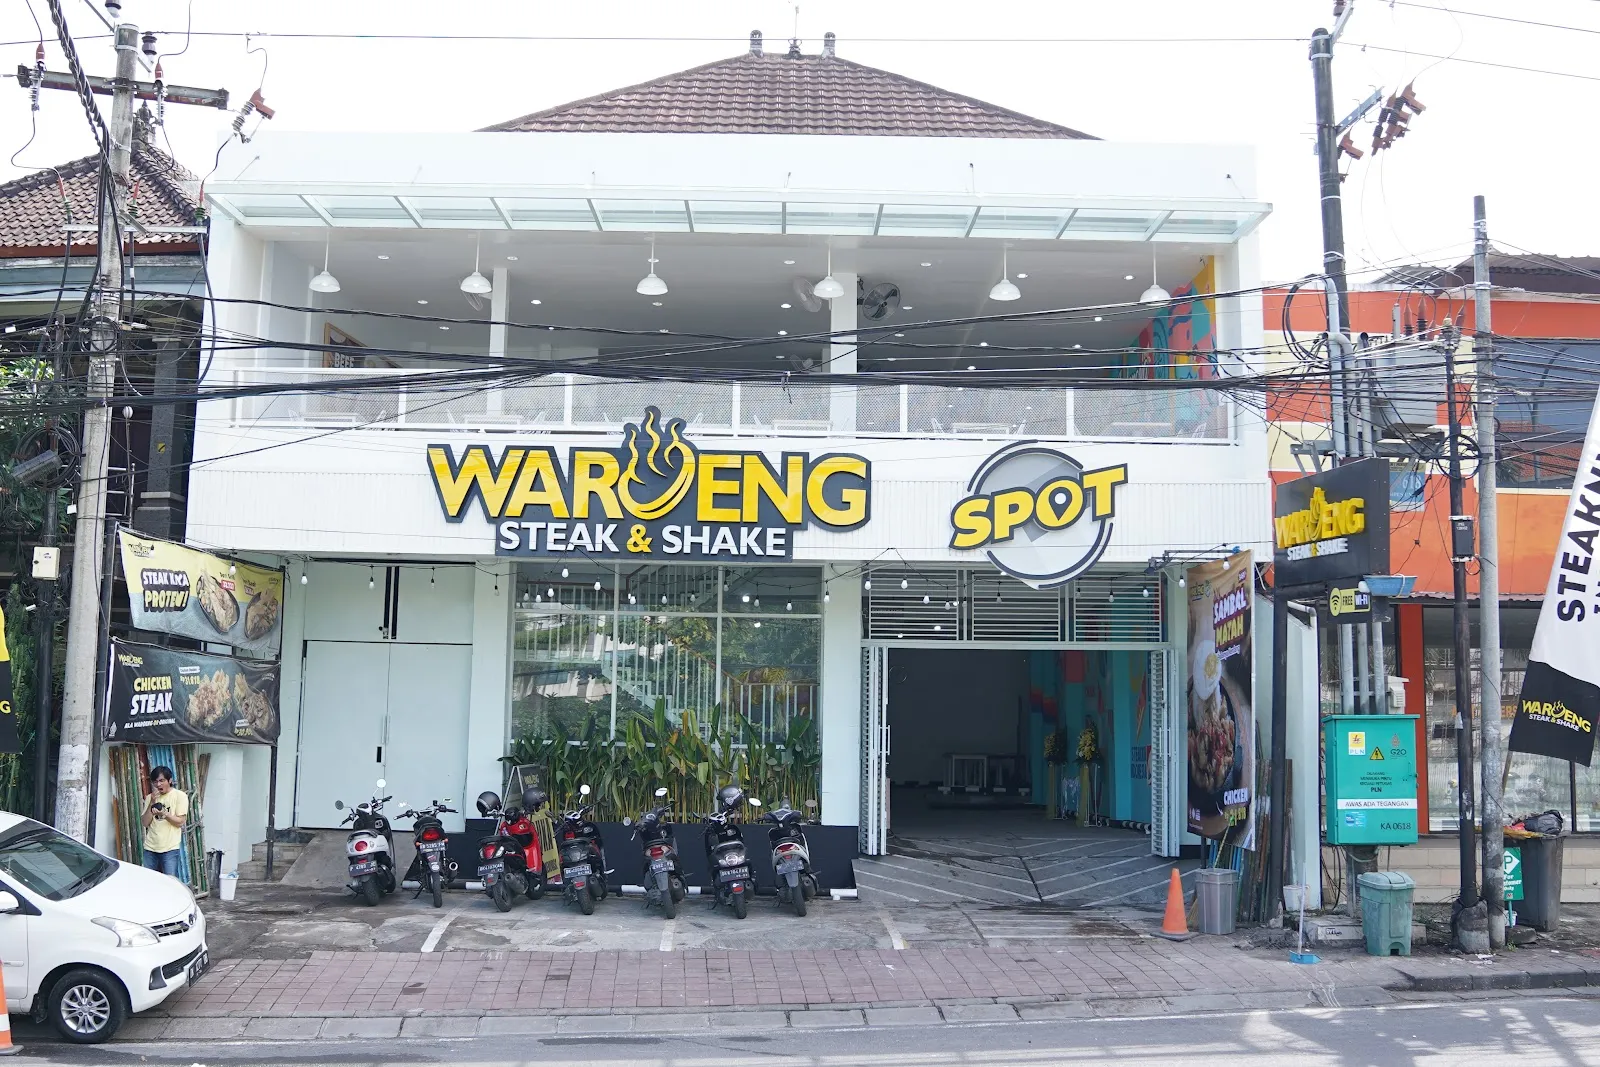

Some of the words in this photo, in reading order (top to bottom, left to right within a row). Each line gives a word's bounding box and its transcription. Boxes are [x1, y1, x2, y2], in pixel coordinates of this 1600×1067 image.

[427, 409, 868, 526] WAROENG
[951, 465, 1126, 548] SPOT
[1275, 487, 1365, 549] WAROENG
[500, 521, 620, 553] STEAK
[626, 524, 652, 554] &
[662, 524, 787, 556] SHAKE
[1287, 543, 1312, 561] STEAK
[1317, 537, 1349, 557] SHAKE
[143, 571, 169, 585] STEAK
[1214, 587, 1247, 624] SAMBAL
[1343, 595, 1353, 606] FREE
[134, 676, 172, 692] CHICKEN
[130, 692, 173, 716] STEAK
[1522, 700, 1592, 733] WAROENG
[1529, 714, 1551, 723] STEAK
[1556, 718, 1580, 732] SHAKE
[1223, 788, 1249, 806] CHICKEN
[1380, 822, 1391, 830] KA
[1392, 822, 1411, 830] 0618
